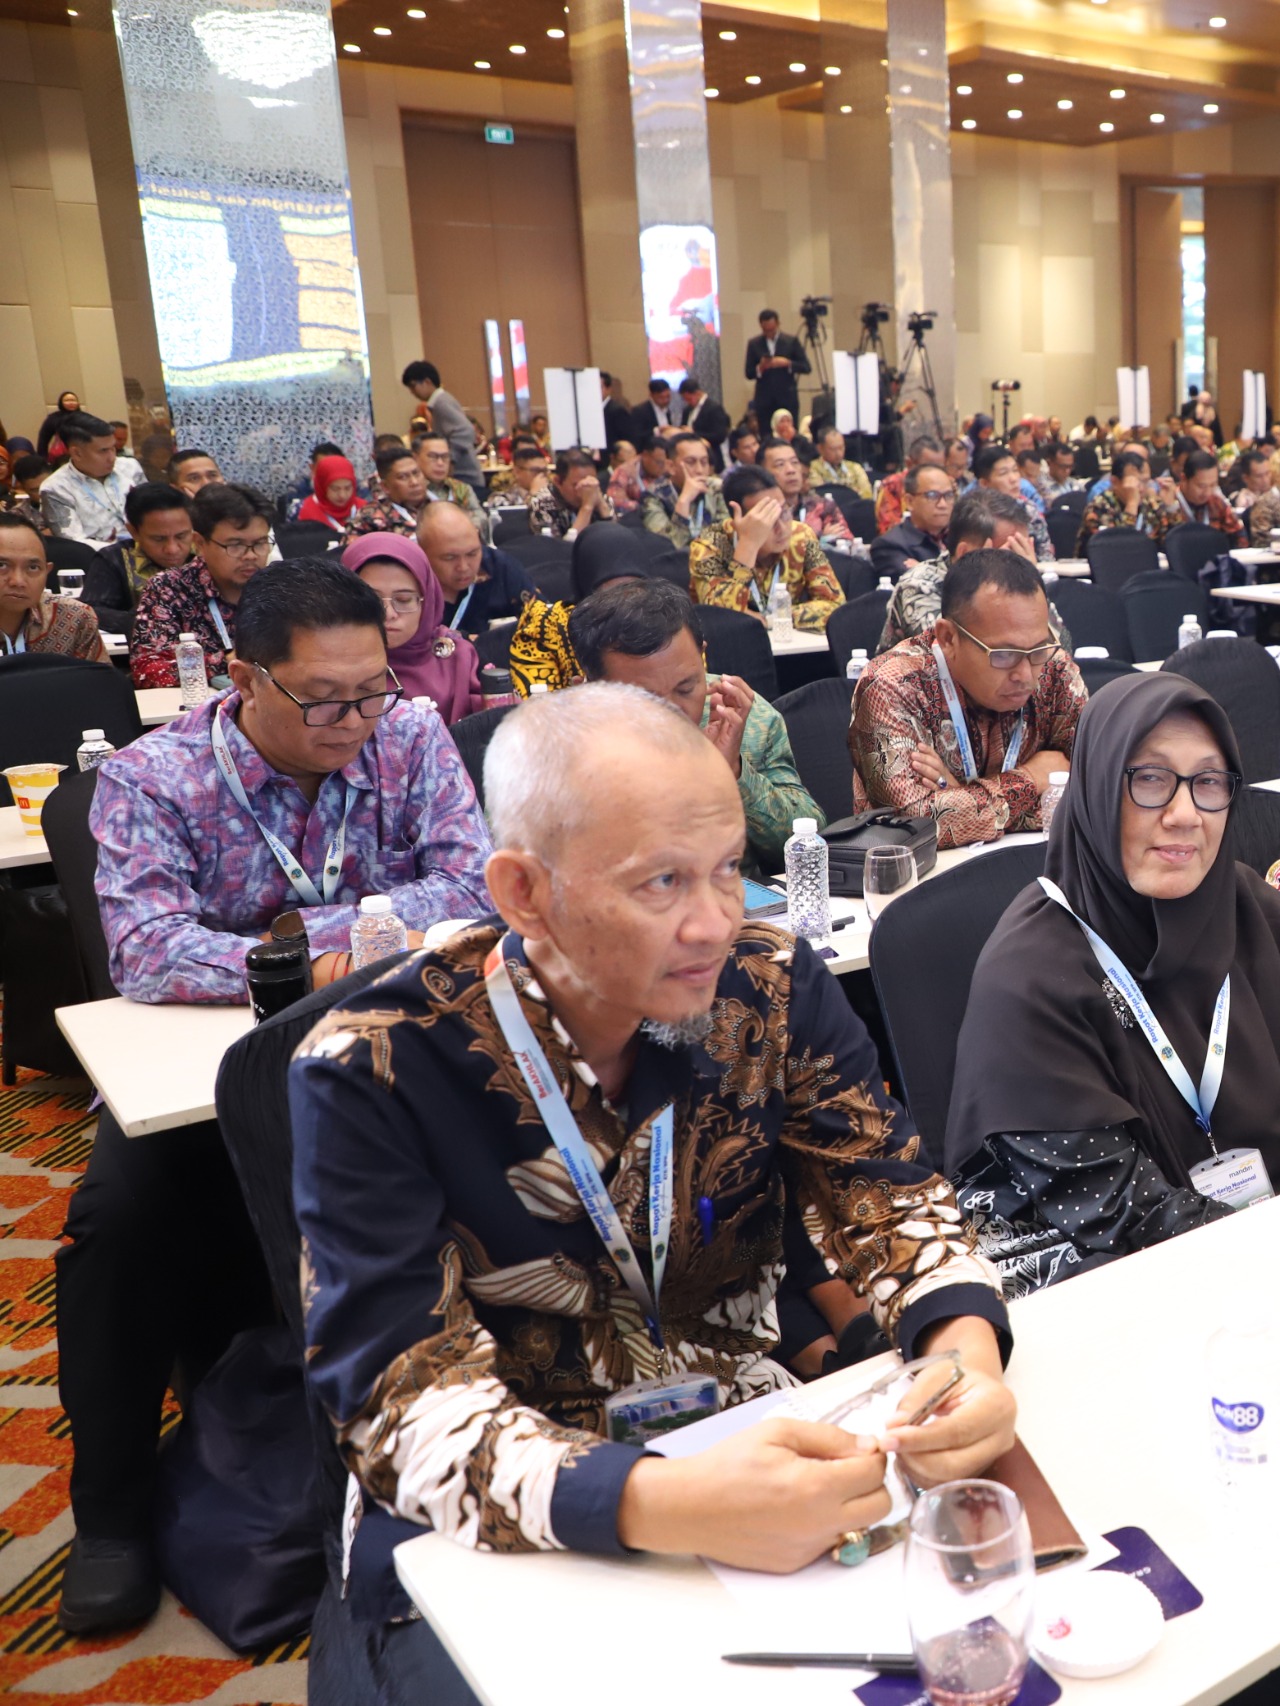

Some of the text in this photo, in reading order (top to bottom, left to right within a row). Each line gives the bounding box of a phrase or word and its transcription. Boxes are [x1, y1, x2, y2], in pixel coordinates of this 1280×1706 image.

[1108, 967, 1133, 999] Nasional
[1130, 996, 1146, 1020] Kerja
[1214, 1010, 1222, 1034] Rapat
[1218, 988, 1226, 1009] Kerja
[1142, 1019, 1158, 1043] Rapat
[653, 1126, 662, 1172] Nasional
[560, 1147, 583, 1190] Nasional
[579, 1186, 598, 1215] Kerja
[652, 1174, 662, 1201] Kerja
[1217, 1186, 1232, 1197] Kerja
[1232, 1174, 1256, 1188] Nasional
[590, 1212, 612, 1242] Rapat
[652, 1203, 661, 1235] Rapat
